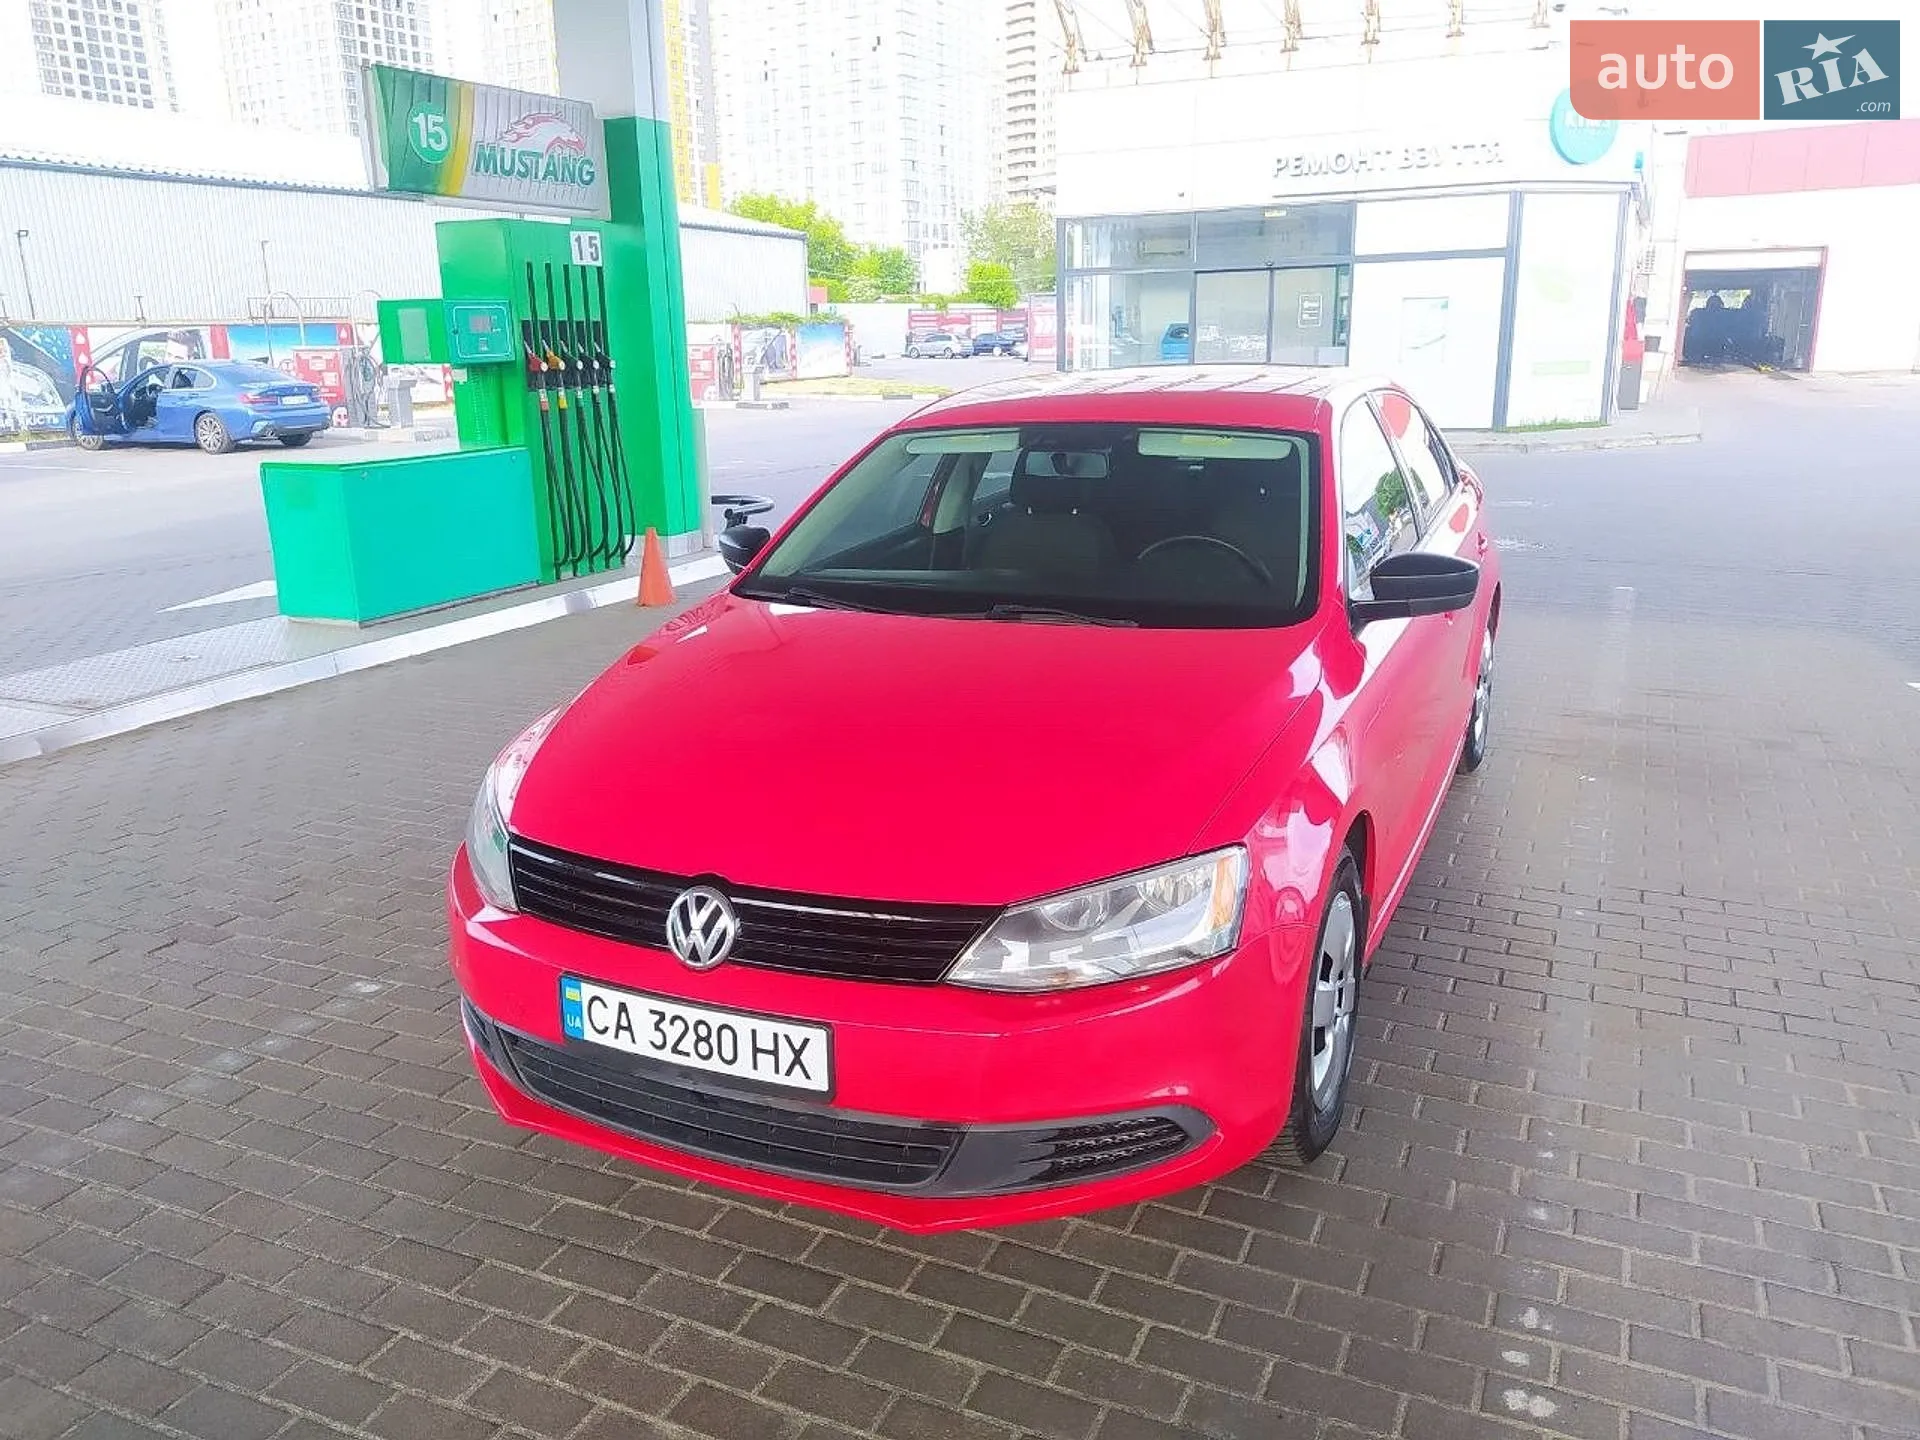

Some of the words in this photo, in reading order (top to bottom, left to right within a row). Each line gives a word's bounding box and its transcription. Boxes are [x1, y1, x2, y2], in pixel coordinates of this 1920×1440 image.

[411, 113, 448, 151] 15
[474, 142, 596, 187] MUSTANG
[574, 234, 600, 262] 15
[567, 1013, 582, 1029] UA
[587, 994, 637, 1044] CA
[649, 1008, 739, 1066] 3280
[751, 1028, 812, 1080] HX
